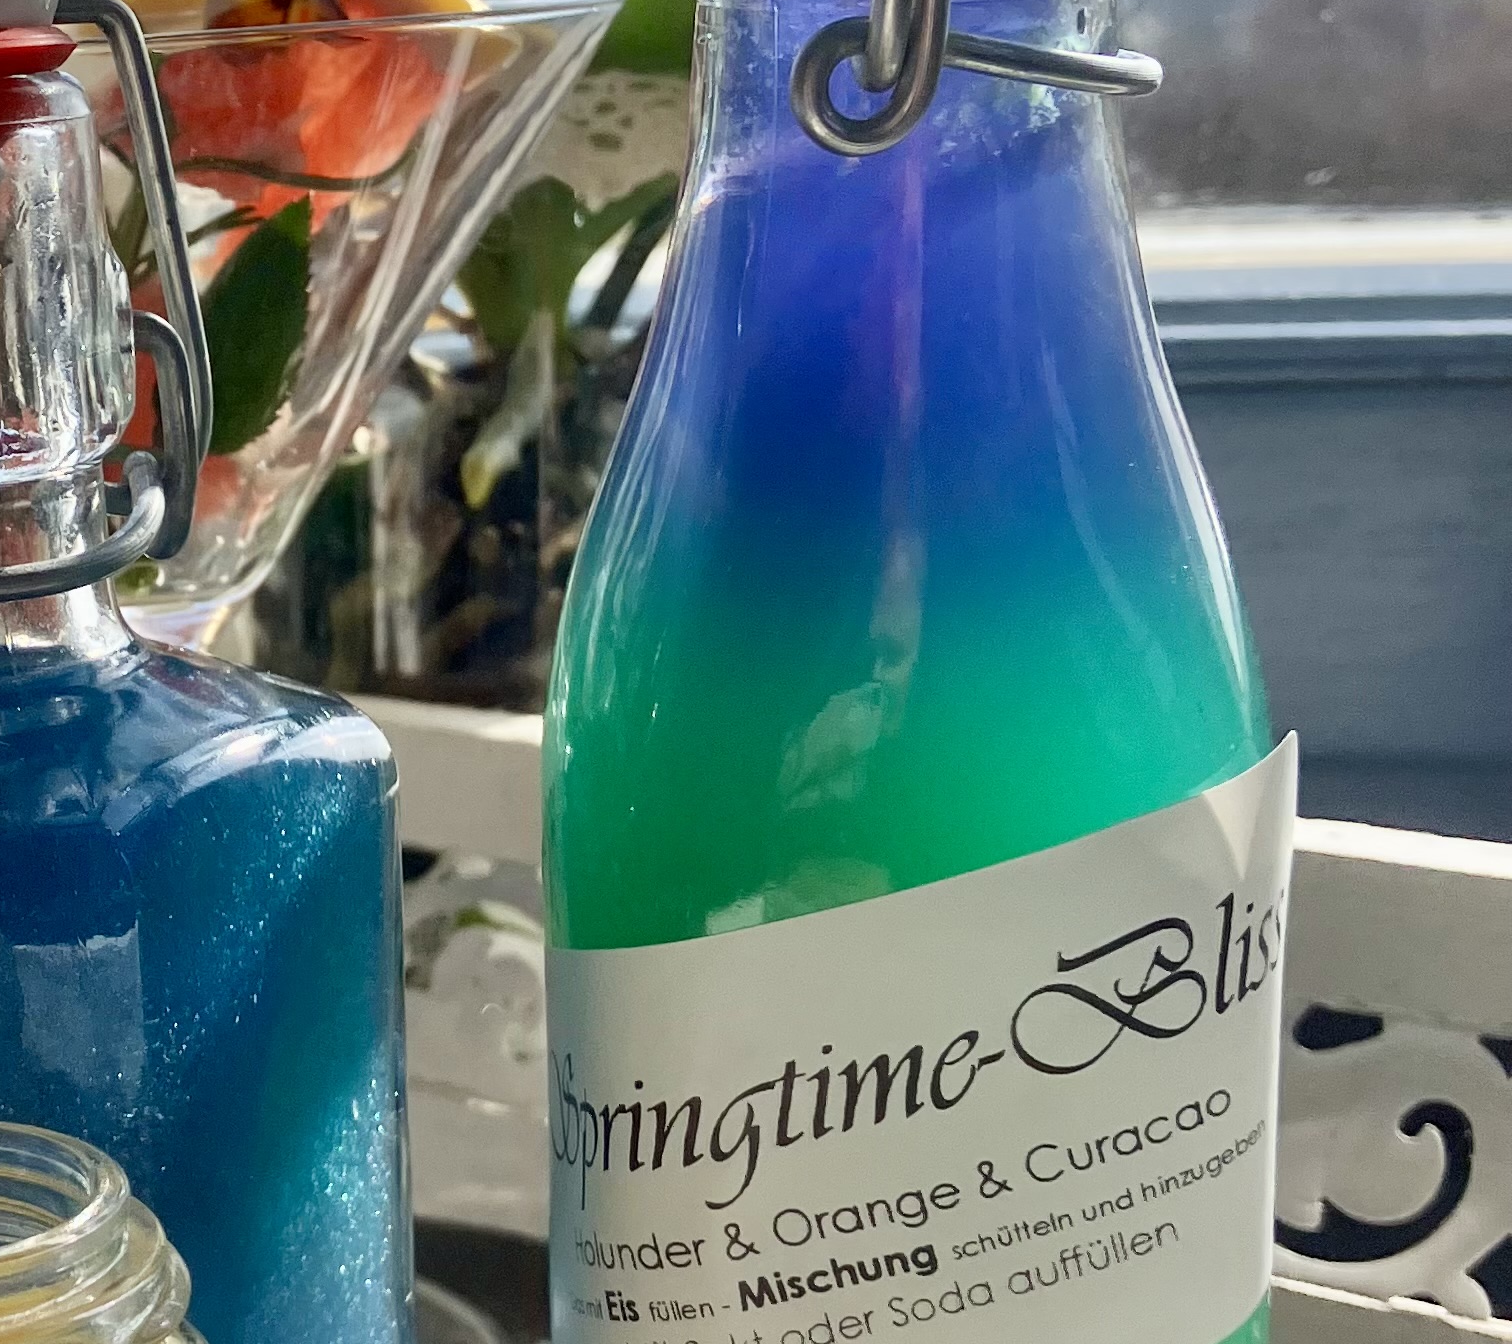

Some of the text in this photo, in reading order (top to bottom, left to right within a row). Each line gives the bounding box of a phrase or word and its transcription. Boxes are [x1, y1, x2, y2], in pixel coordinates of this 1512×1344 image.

[605, 1290, 640, 1322] Eis
[648, 1300, 715, 1322] füllen
[738, 1244, 939, 1312] Mischung
[951, 1211, 1074, 1260] schütteln
[1082, 1188, 1134, 1222] und
[1141, 1119, 1265, 1202] hinzugeben
[724, 1222, 760, 1261] &
[772, 1182, 961, 1247] Orange
[976, 1160, 1014, 1199] &
[1025, 1089, 1232, 1183] Curacao
[888, 1280, 995, 1327] Soda
[1007, 1221, 1179, 1295] auffüllen
